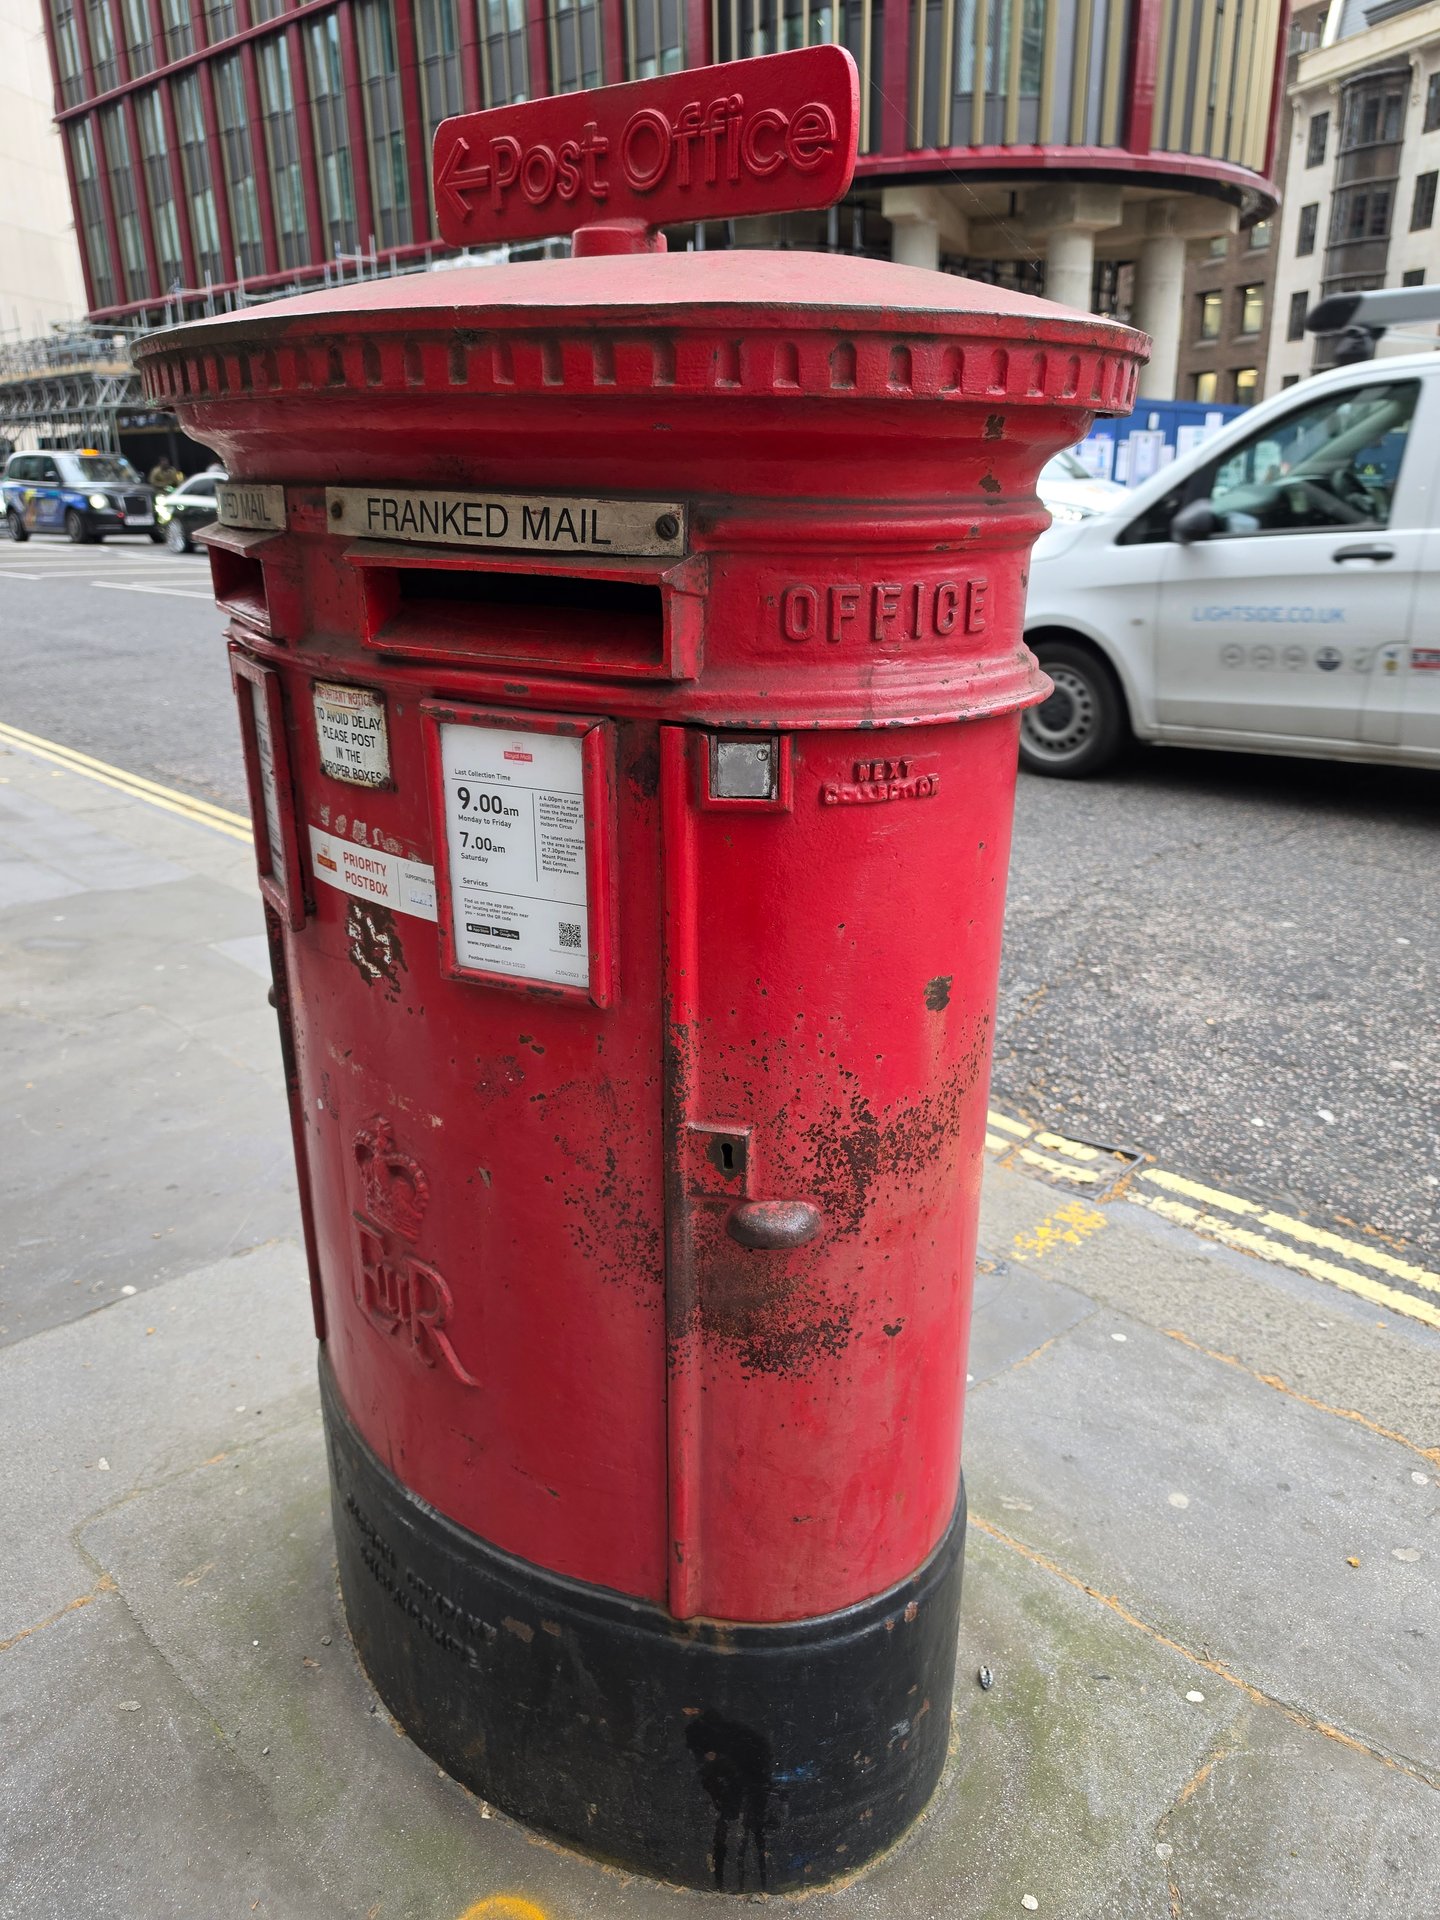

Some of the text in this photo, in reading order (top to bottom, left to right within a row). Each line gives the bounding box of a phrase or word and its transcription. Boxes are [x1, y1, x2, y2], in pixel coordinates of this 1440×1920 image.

[490, 93, 839, 211] Post Office
[240, 493, 271, 521] MAIL
[367, 497, 612, 545] FRANKED MAIL
[782, 577, 988, 641] OFFICE
[316, 706, 381, 731] TO AVOID DELAY
[322, 725, 376, 748] PLEASE POST
[335, 746, 362, 764] IN THE
[325, 759, 382, 784] PROPER BOXES
[454, 768, 511, 781] Last Collection Time
[853, 758, 914, 782] NEXT
[457, 786, 519, 816] 9.00am
[458, 815, 482, 825] Monday
[492, 820, 511, 828] Friday
[459, 831, 506, 853] 7.00am
[343, 851, 387, 877] PRIORITY
[460, 852, 489, 863] Saturday
[345, 870, 388, 897] POSTBOX
[462, 877, 489, 887] Services
[467, 940, 512, 951] www.royalmail.com
